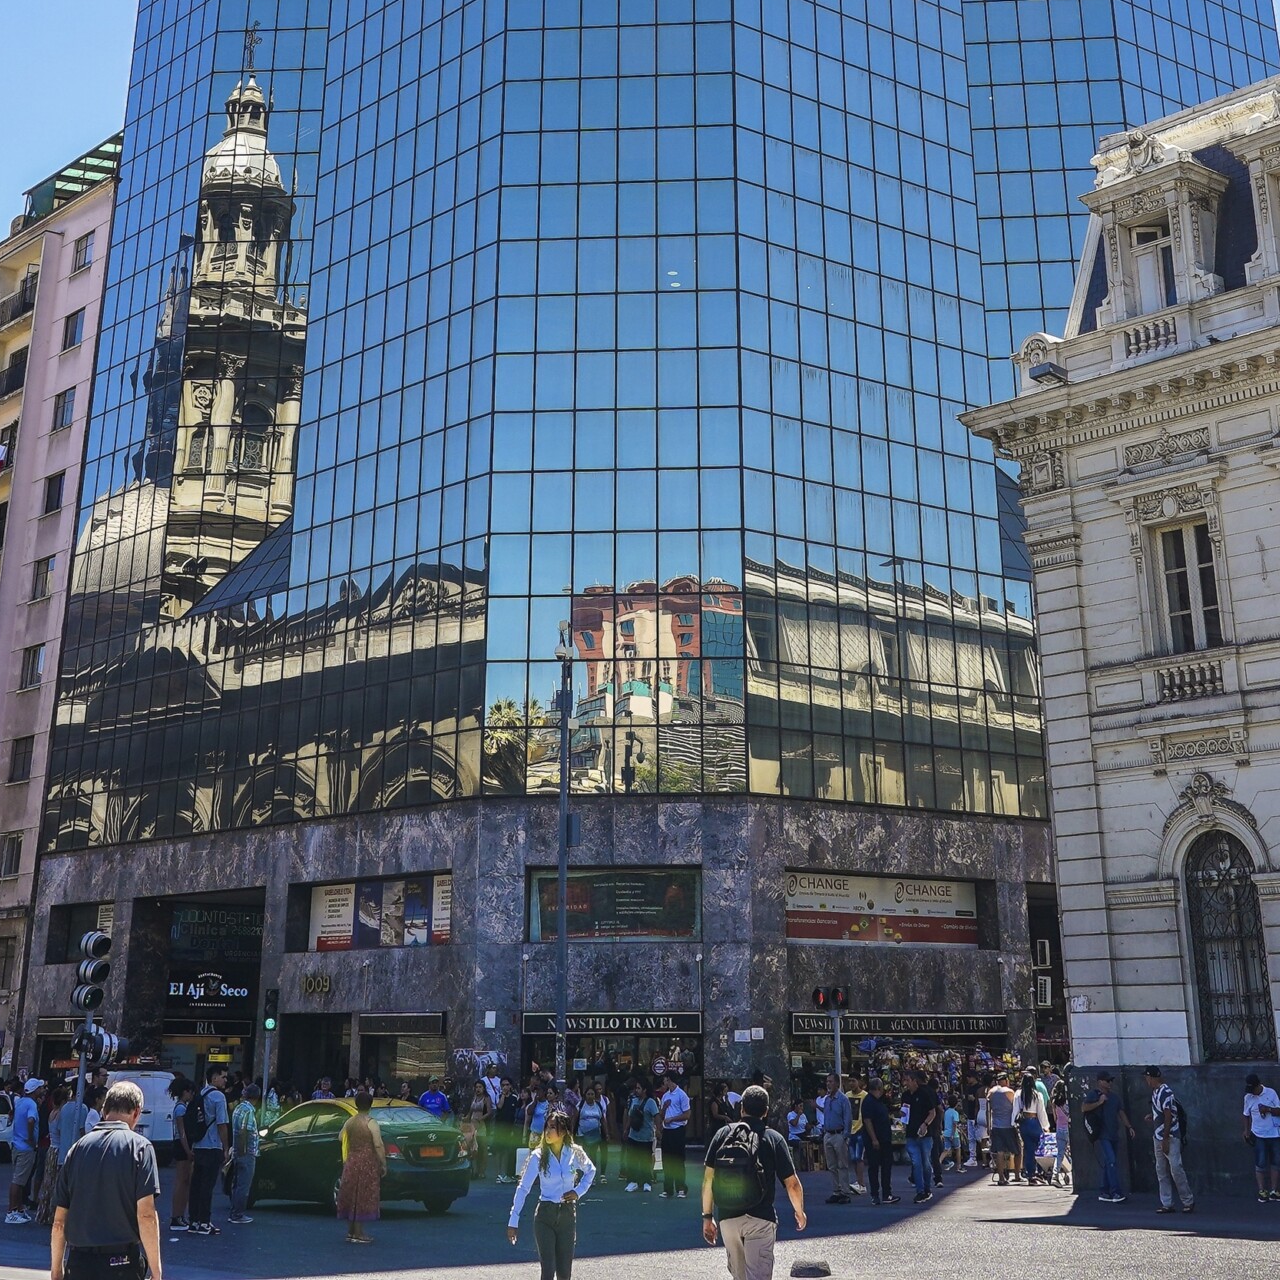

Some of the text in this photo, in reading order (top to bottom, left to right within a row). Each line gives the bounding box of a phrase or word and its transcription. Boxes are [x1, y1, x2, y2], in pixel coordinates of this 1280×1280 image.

[169, 982, 248, 999] El Ají Seco
[196, 1022, 216, 1035] RIA
[547, 1017, 677, 1029] NWSTILO TRAVEL
[847, 1018, 881, 1031] TRAVEL
[890, 1020, 925, 1031] AGENCIA
[926, 1020, 937, 1031] DE
